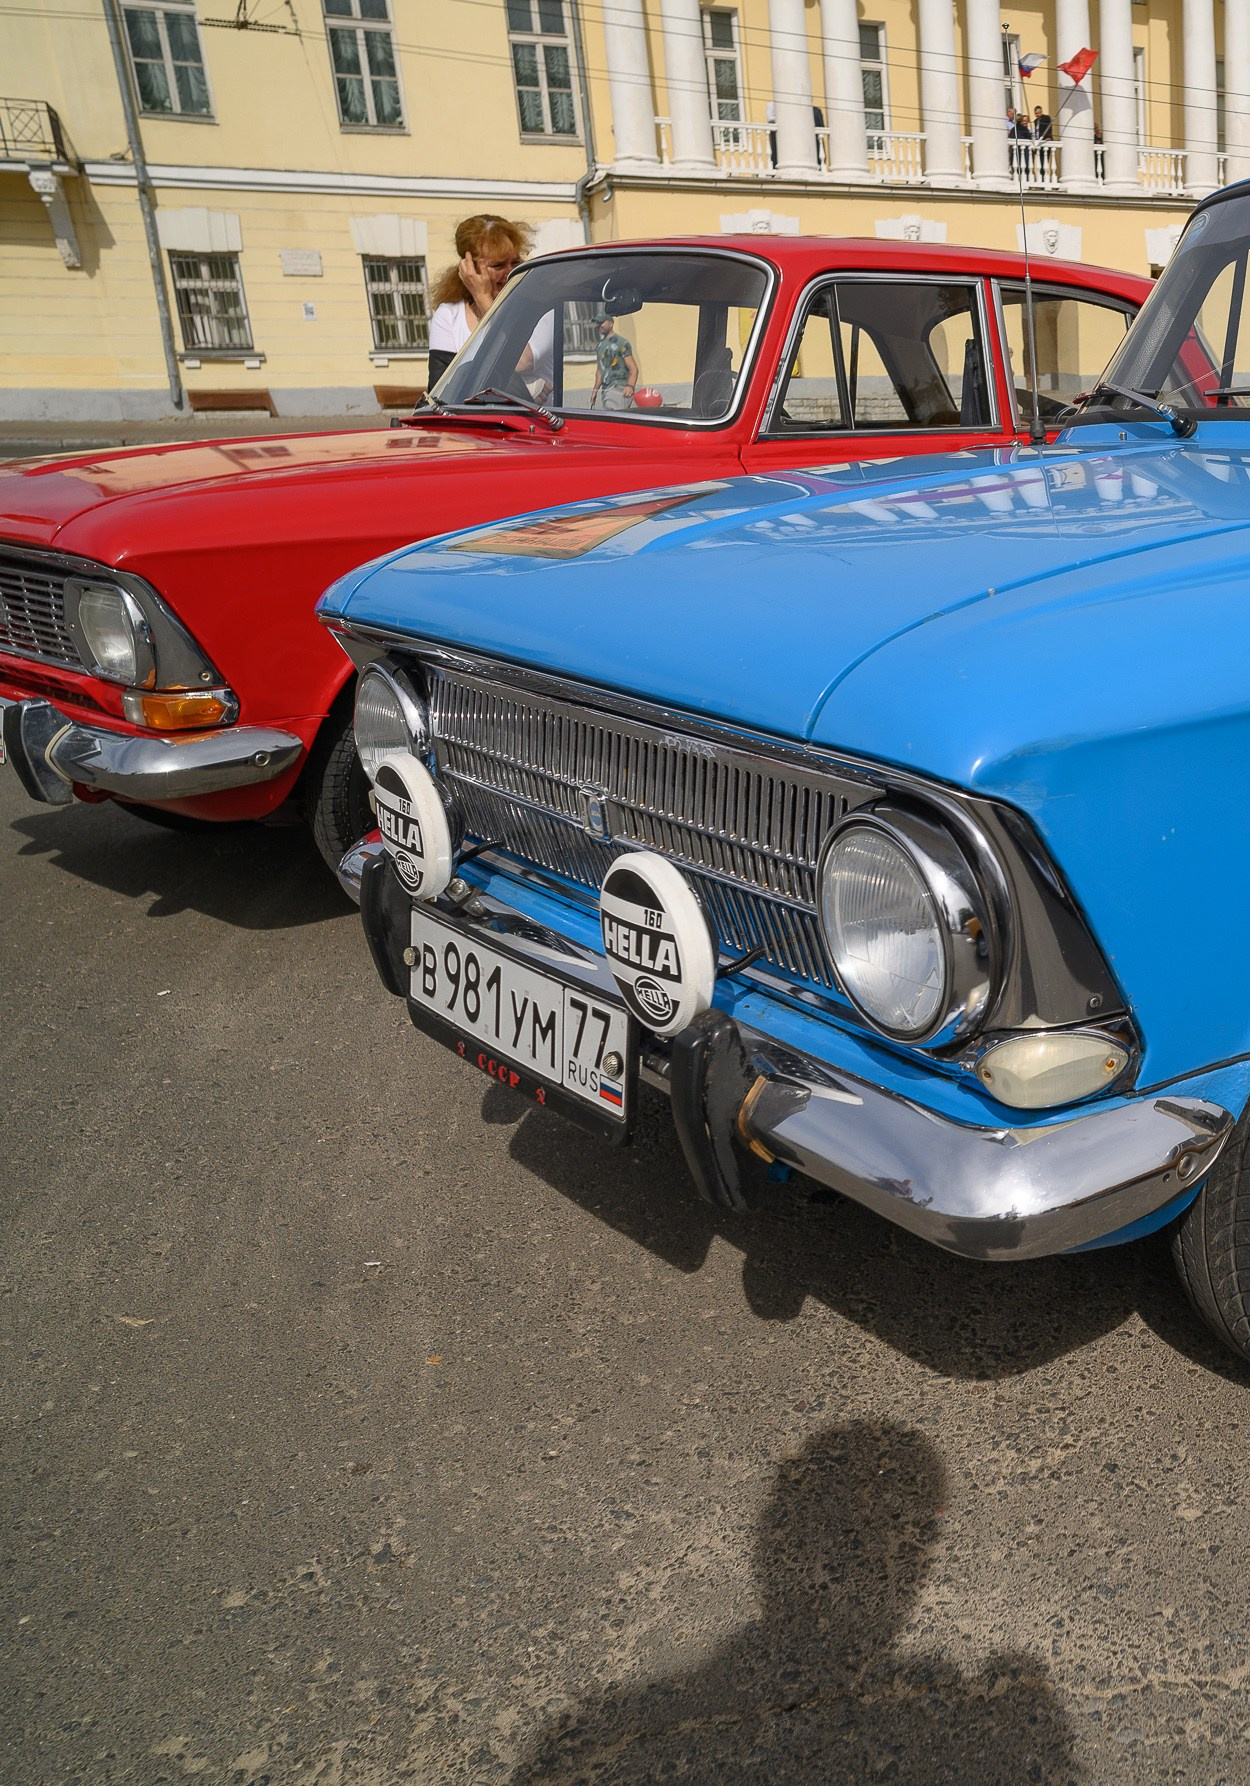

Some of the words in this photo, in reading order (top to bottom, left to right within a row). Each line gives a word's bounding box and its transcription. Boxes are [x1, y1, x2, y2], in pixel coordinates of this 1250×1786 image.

[399, 799, 411, 815] 160
[376, 802, 422, 852] HELLA
[644, 909, 663, 930] 160
[604, 916, 679, 976] HELLA
[637, 987, 671, 1011] HELLA
[569, 996, 611, 1070] 77
[477, 1053, 520, 1088] СССР
[568, 1059, 599, 1093] RUS
